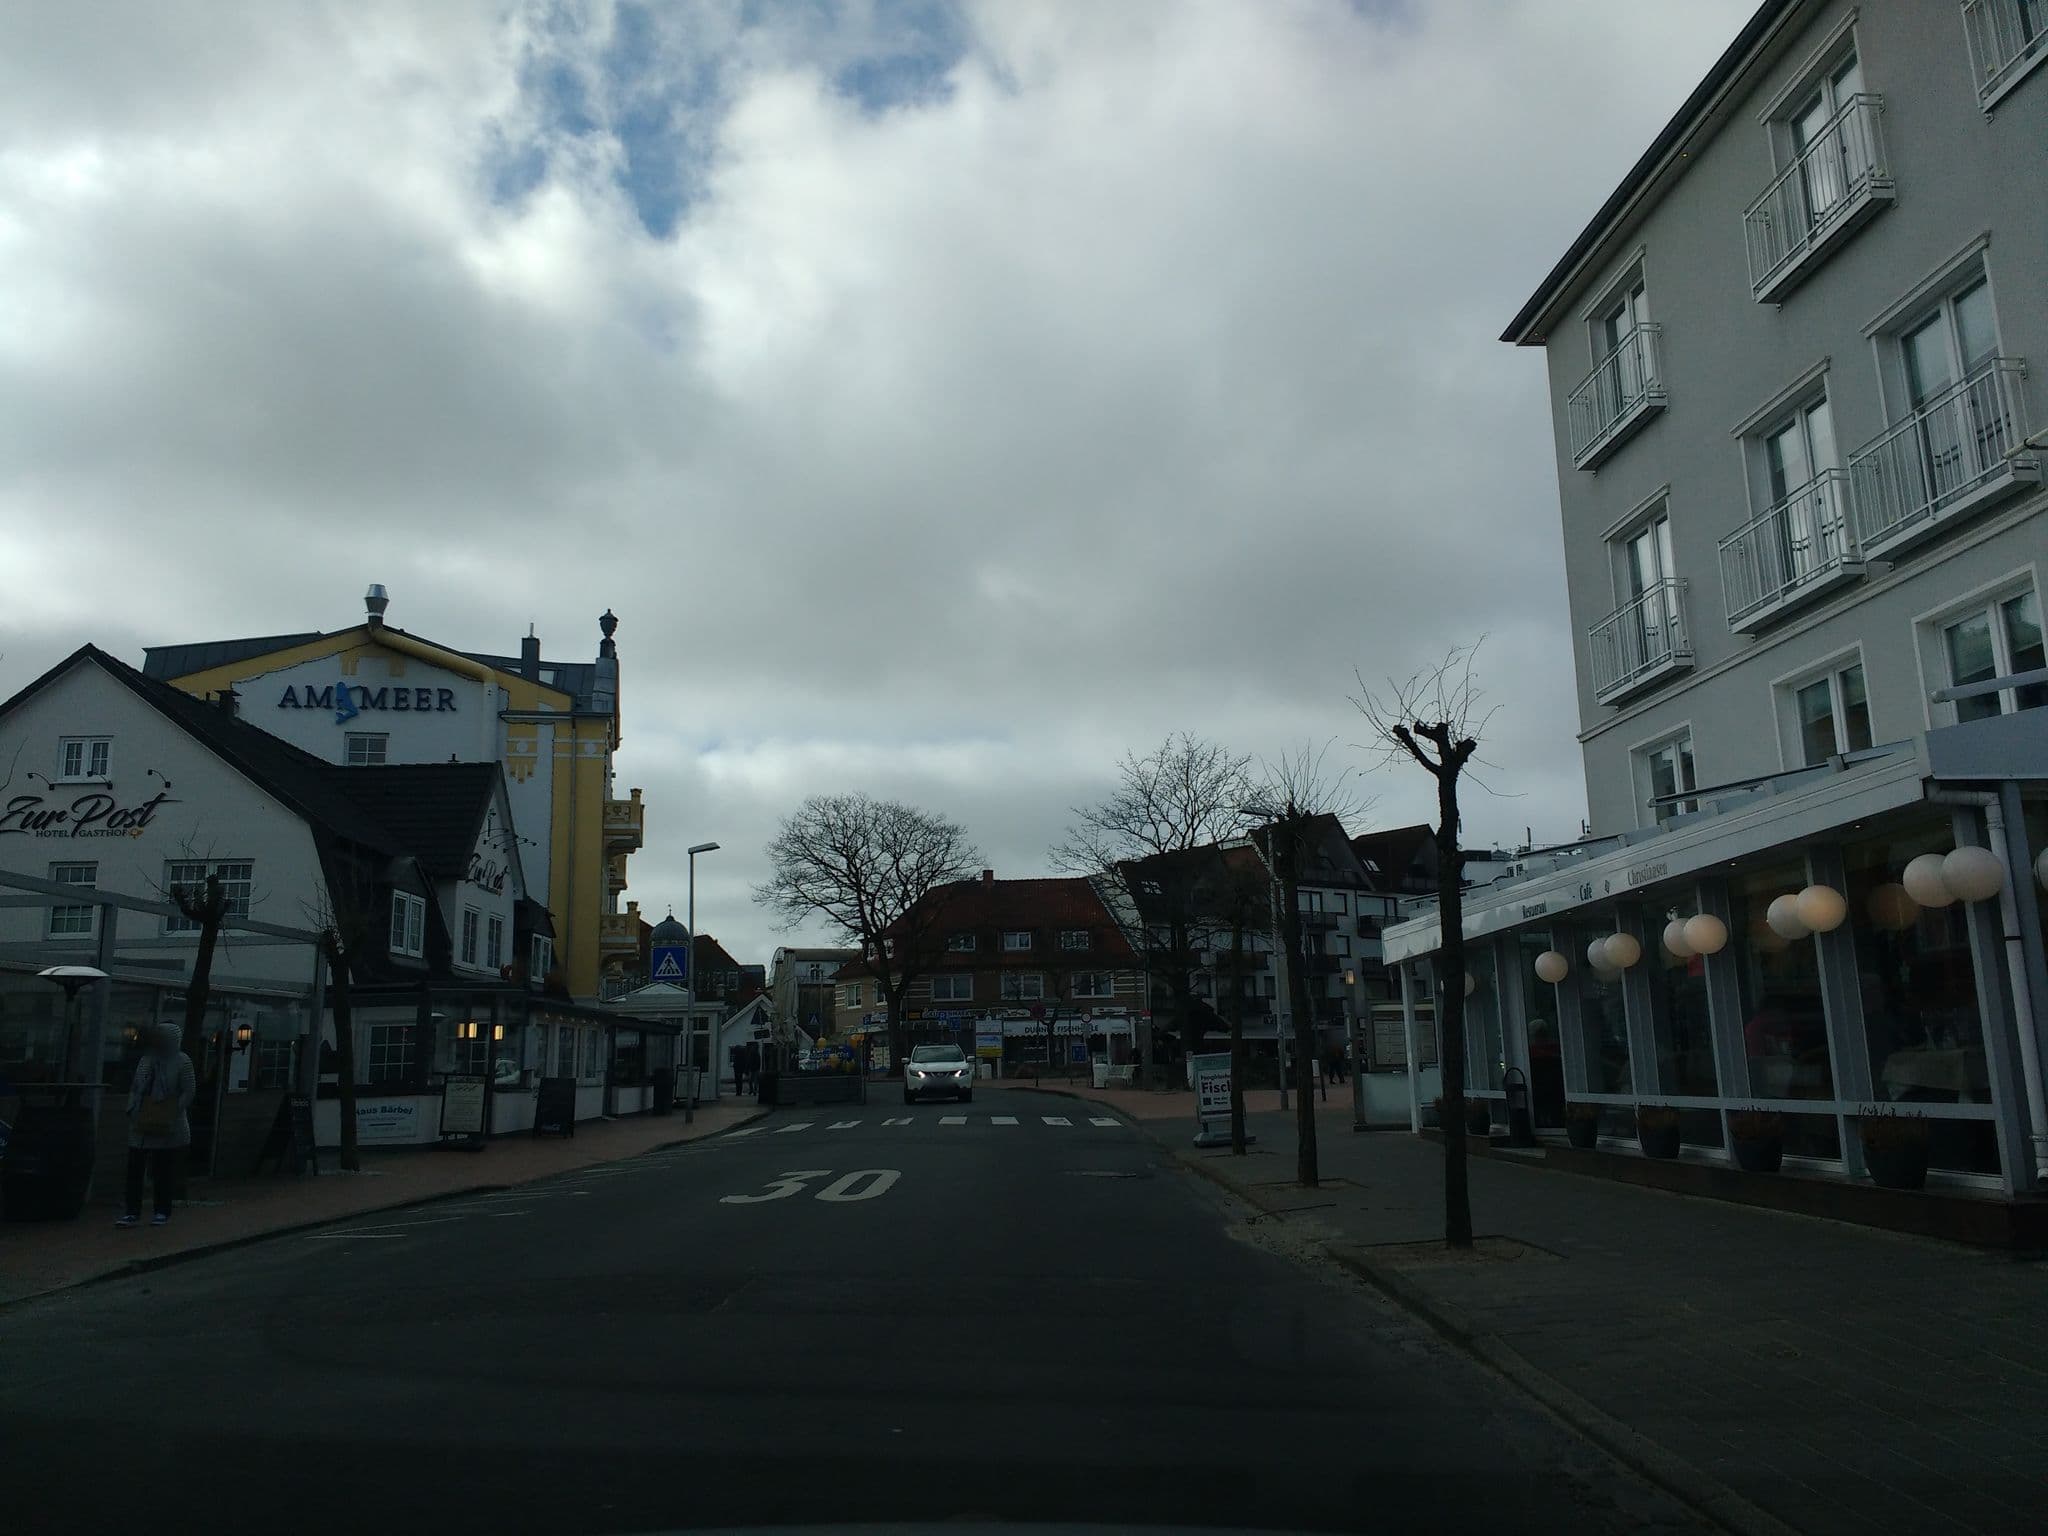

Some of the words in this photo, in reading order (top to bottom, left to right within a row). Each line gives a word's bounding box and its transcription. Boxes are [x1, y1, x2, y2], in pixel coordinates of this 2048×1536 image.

[278, 684, 334, 709] AM
[359, 686, 457, 712] MEER
[0, 795, 69, 834] Zur
[71, 793, 183, 838] Post
[36, 829, 70, 838] HOTEL
[79, 829, 127, 838] GASTHOF
[719, 1168, 902, 1204] 30
